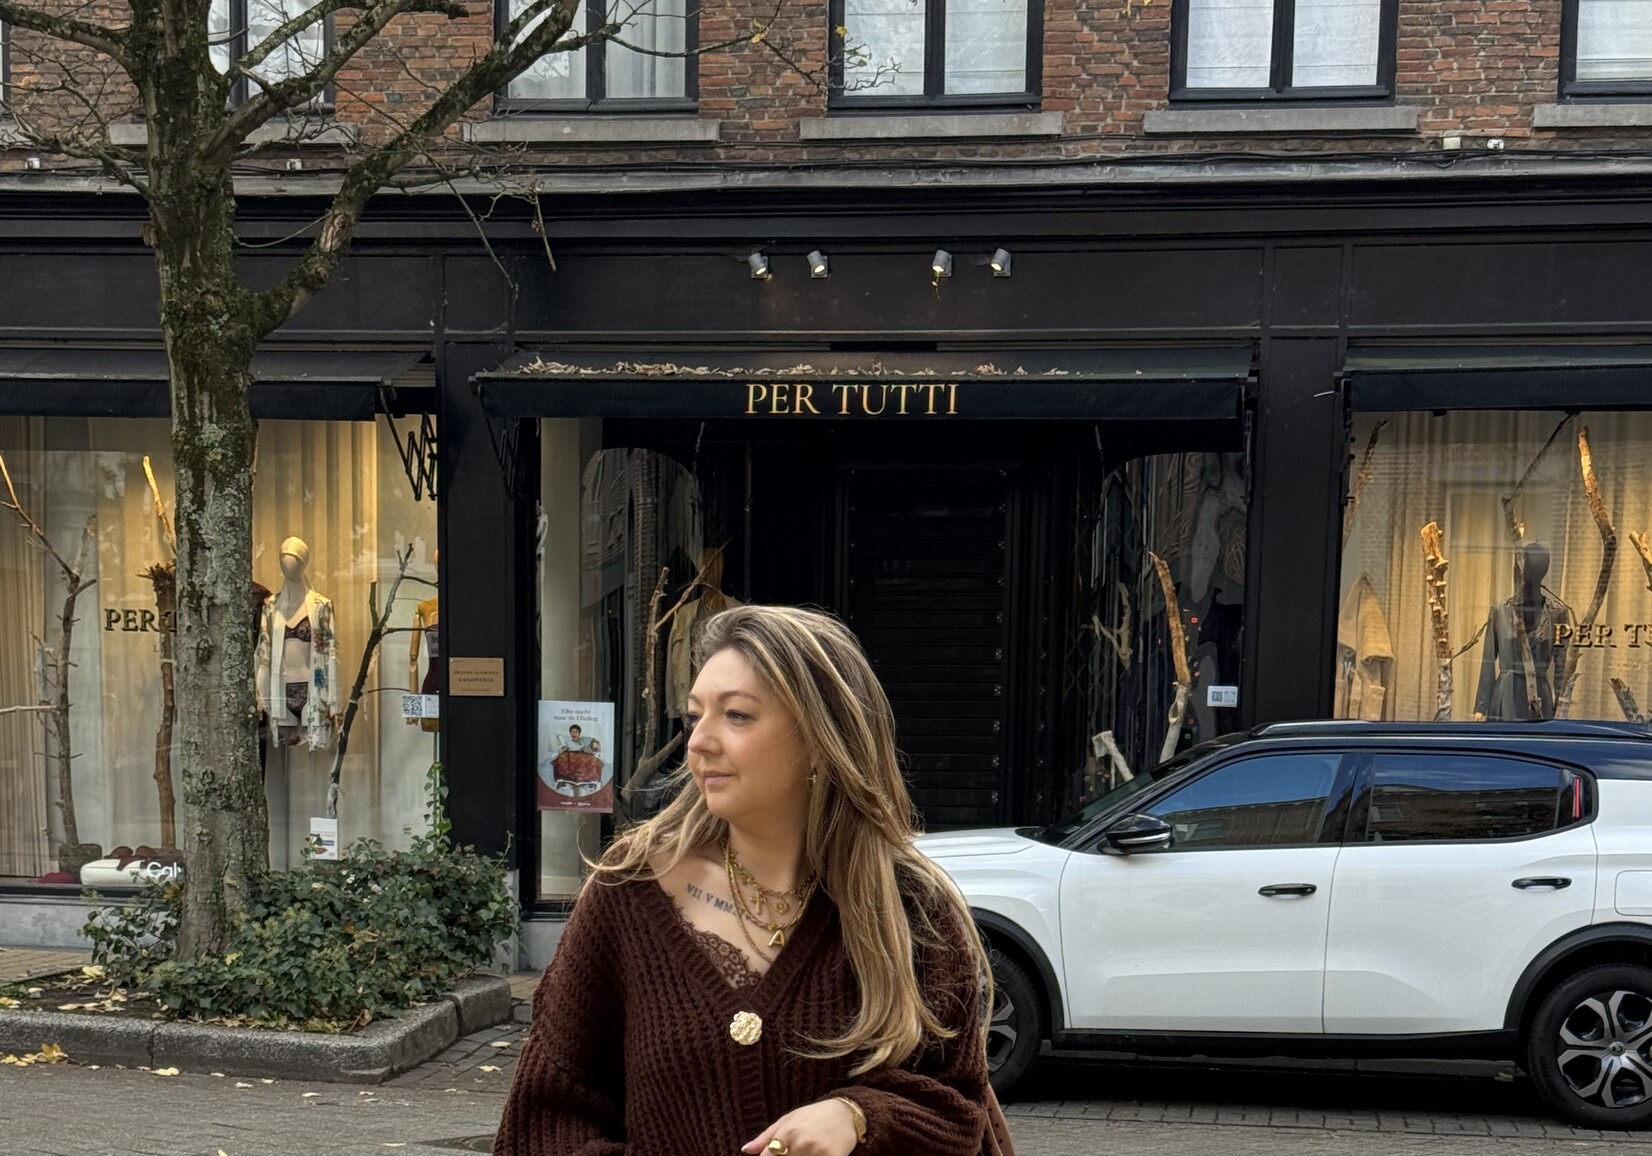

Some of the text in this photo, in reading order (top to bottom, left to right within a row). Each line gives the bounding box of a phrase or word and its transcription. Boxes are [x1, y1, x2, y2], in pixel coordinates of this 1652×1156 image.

[744, 383, 959, 415] PER TUTTI
[104, 608, 160, 632] PER
[1552, 623, 1618, 648] PER
[687, 883, 703, 900] VII
